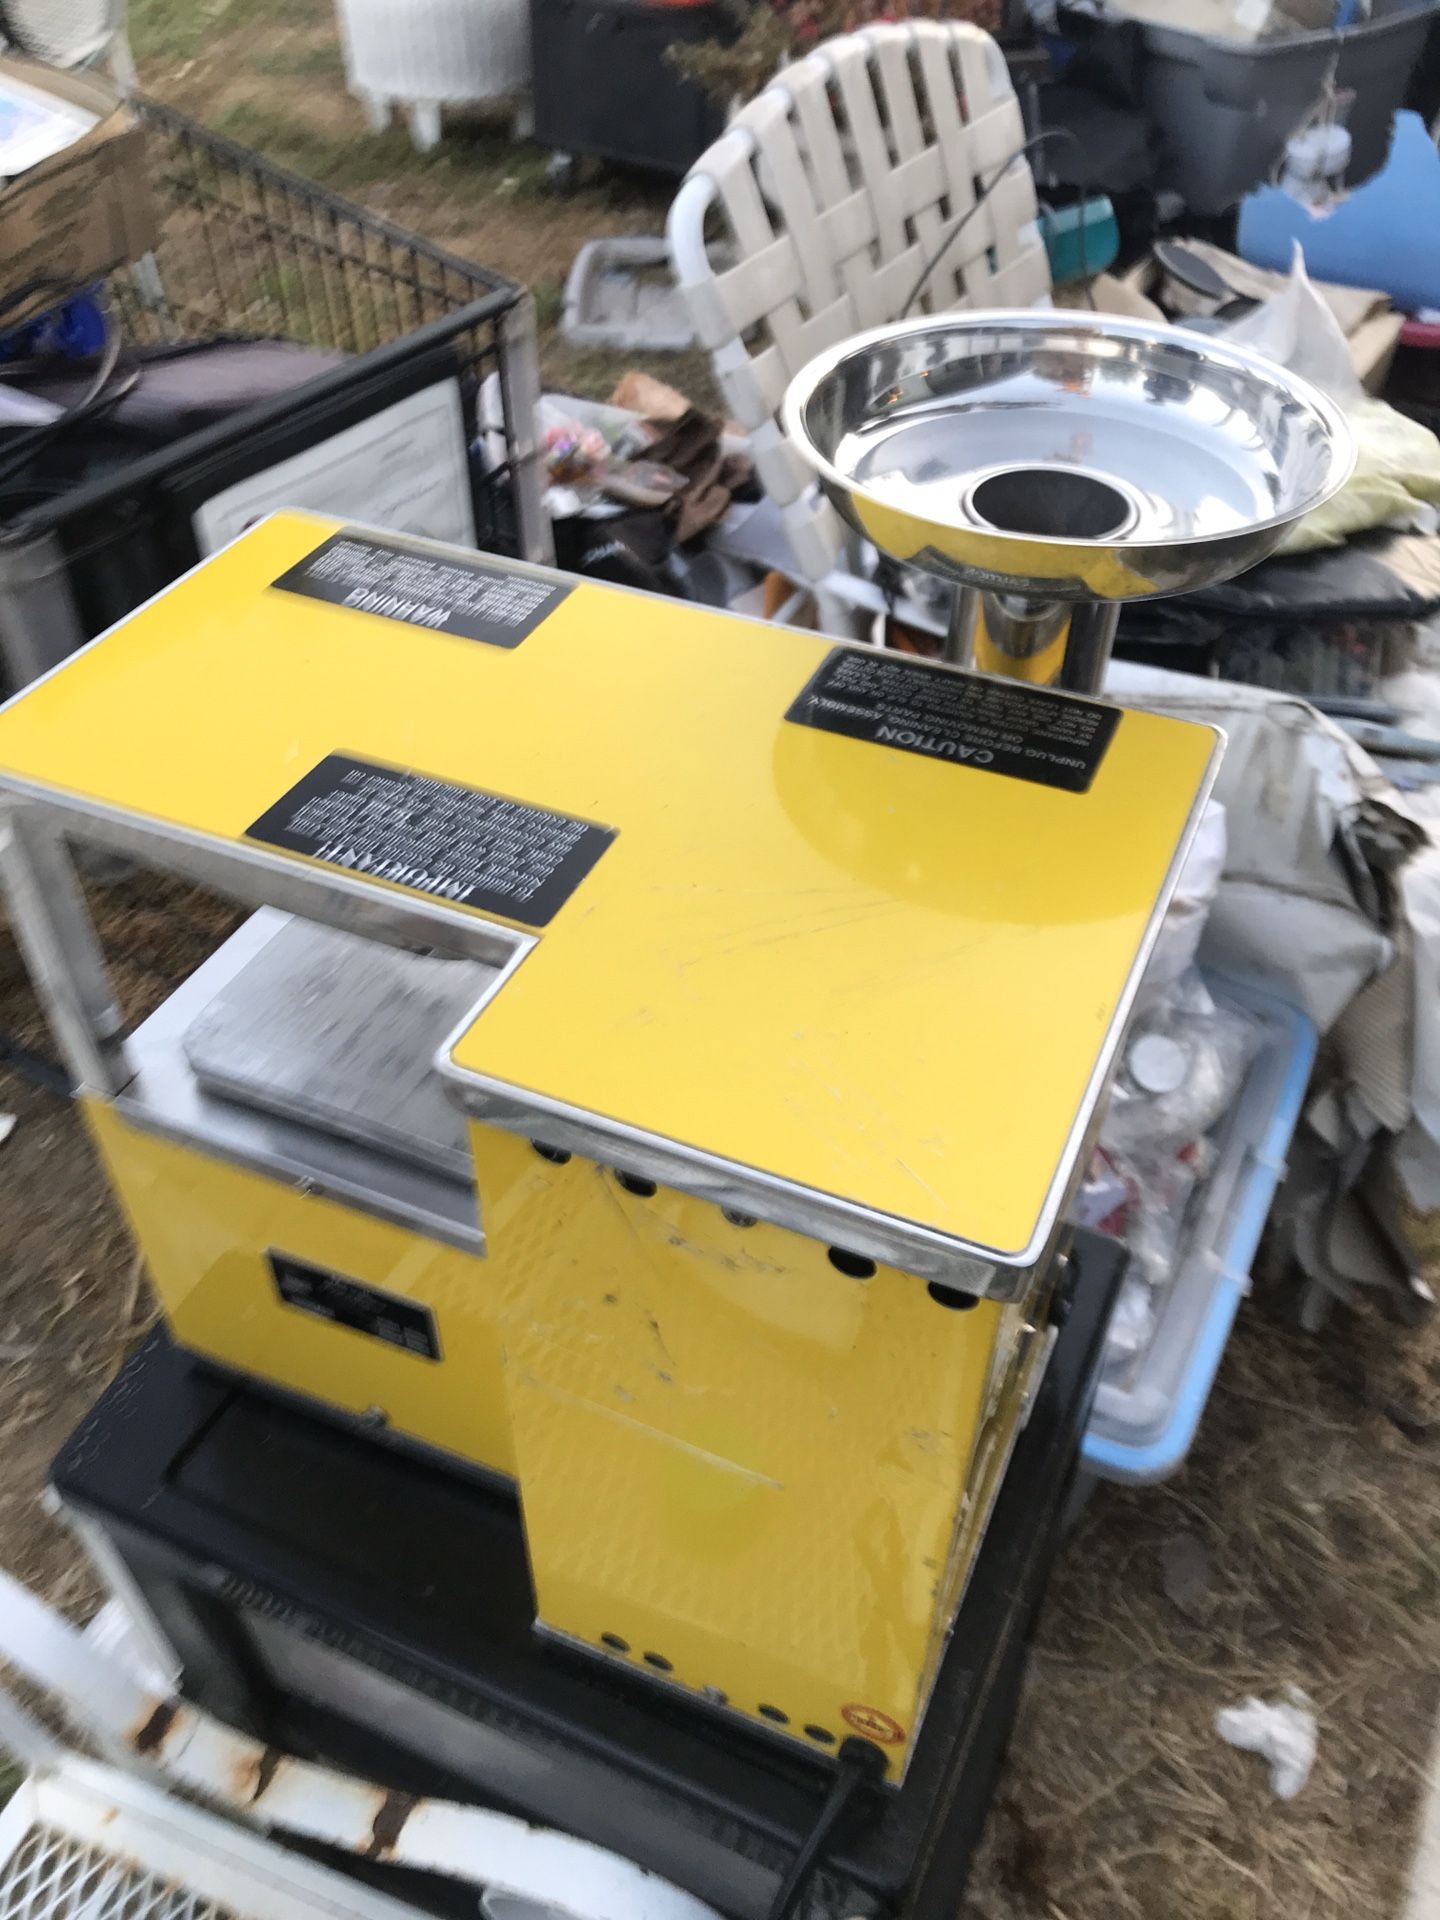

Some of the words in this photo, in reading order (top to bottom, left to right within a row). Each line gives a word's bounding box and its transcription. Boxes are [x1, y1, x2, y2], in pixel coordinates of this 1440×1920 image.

[340, 588, 451, 629] WARNING
[875, 702, 921, 718] PARTS
[922, 713, 999, 737] REMOVING
[873, 723, 996, 765] CAUTION
[961, 733, 1023, 754] BEFORE
[998, 731, 1023, 743] OR
[1023, 747, 1087, 769] UNPLUG
[311, 841, 475, 901] IMPORTANT!
